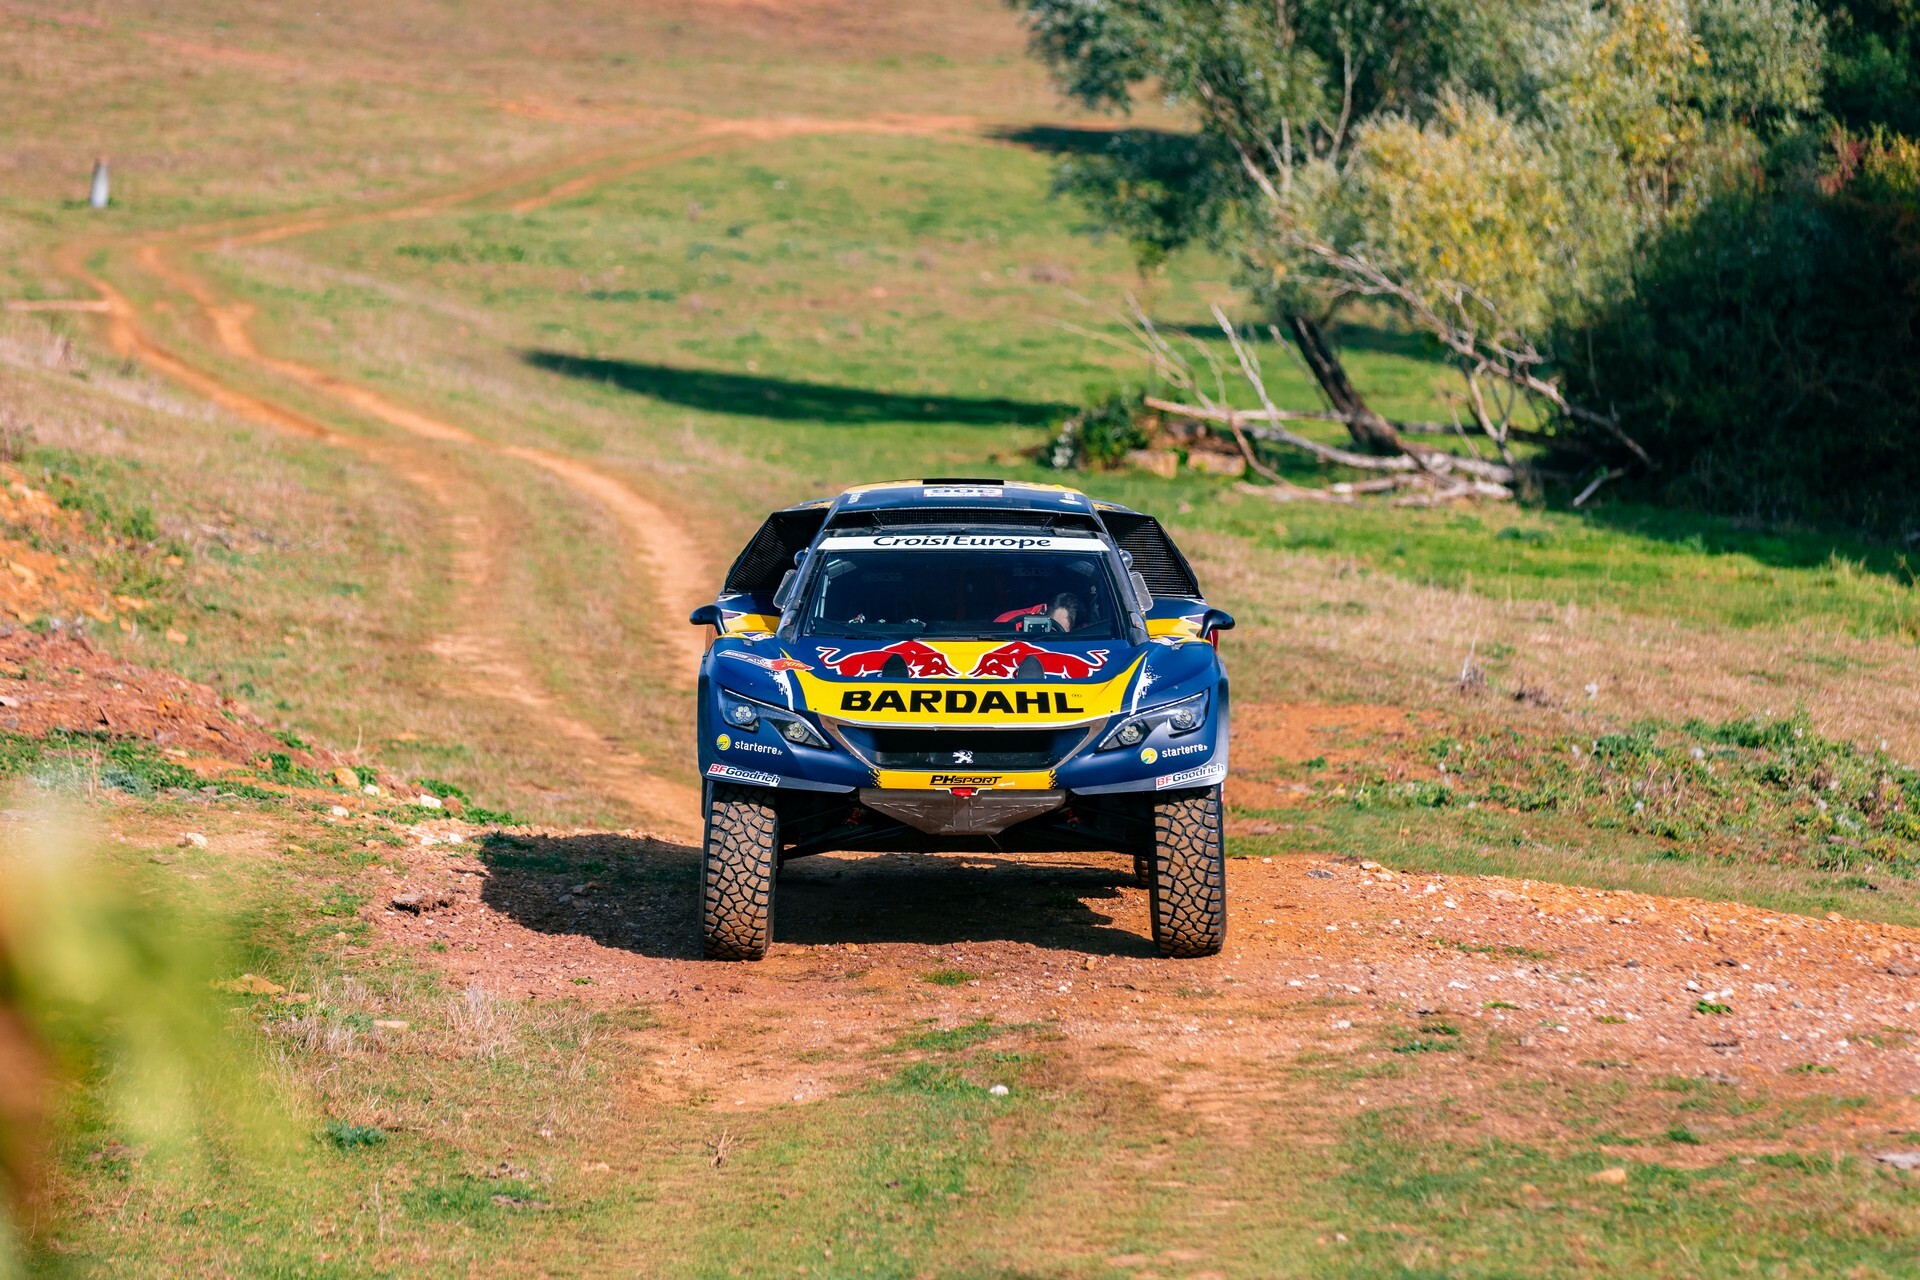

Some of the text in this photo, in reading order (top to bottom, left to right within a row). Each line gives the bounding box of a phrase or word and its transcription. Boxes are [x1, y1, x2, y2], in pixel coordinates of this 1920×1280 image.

[873, 535, 1051, 549] CroisiEurope
[840, 690, 1085, 714] BARDAHL
[709, 764, 780, 783] BFGoodrich
[1157, 764, 1224, 787] BFGoodrich
